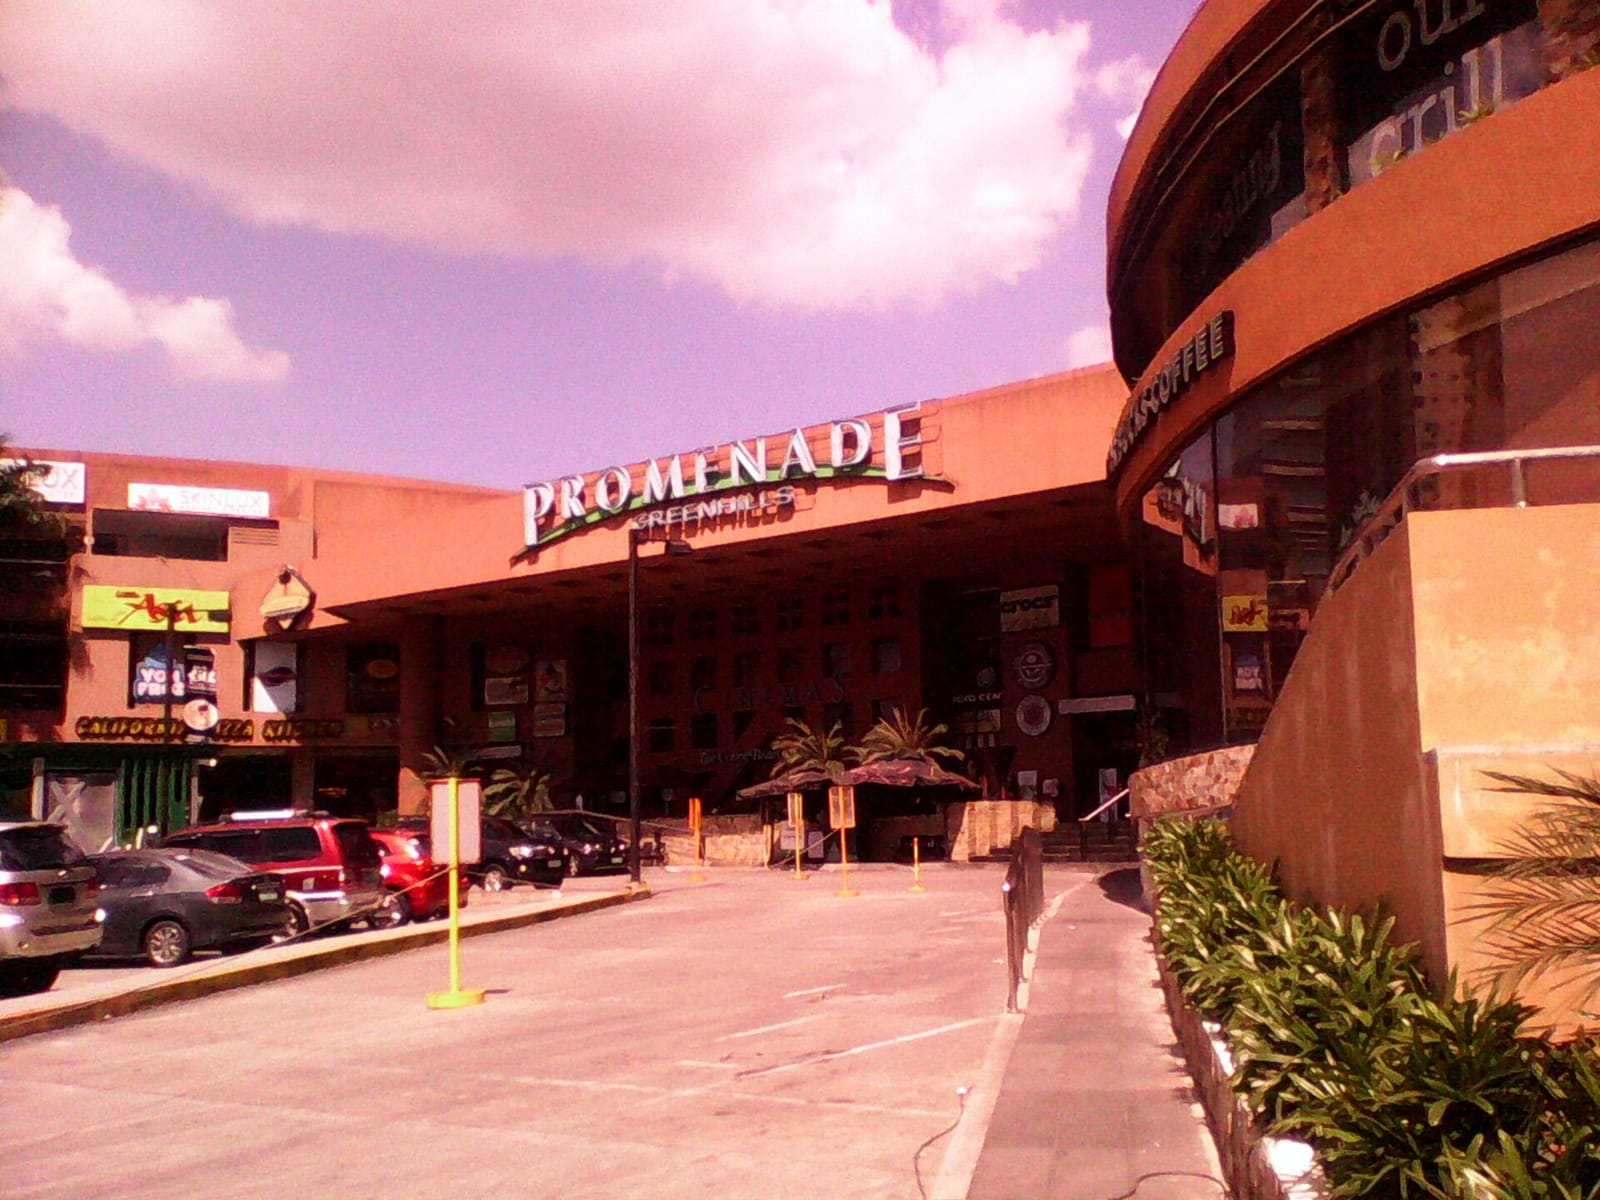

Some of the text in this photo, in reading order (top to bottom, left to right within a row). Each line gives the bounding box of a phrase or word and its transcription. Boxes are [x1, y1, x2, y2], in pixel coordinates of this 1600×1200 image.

[522, 401, 923, 548] PROMENADE
[633, 486, 797, 530] GREENHILLS
[213, 718, 253, 738] IZZA
